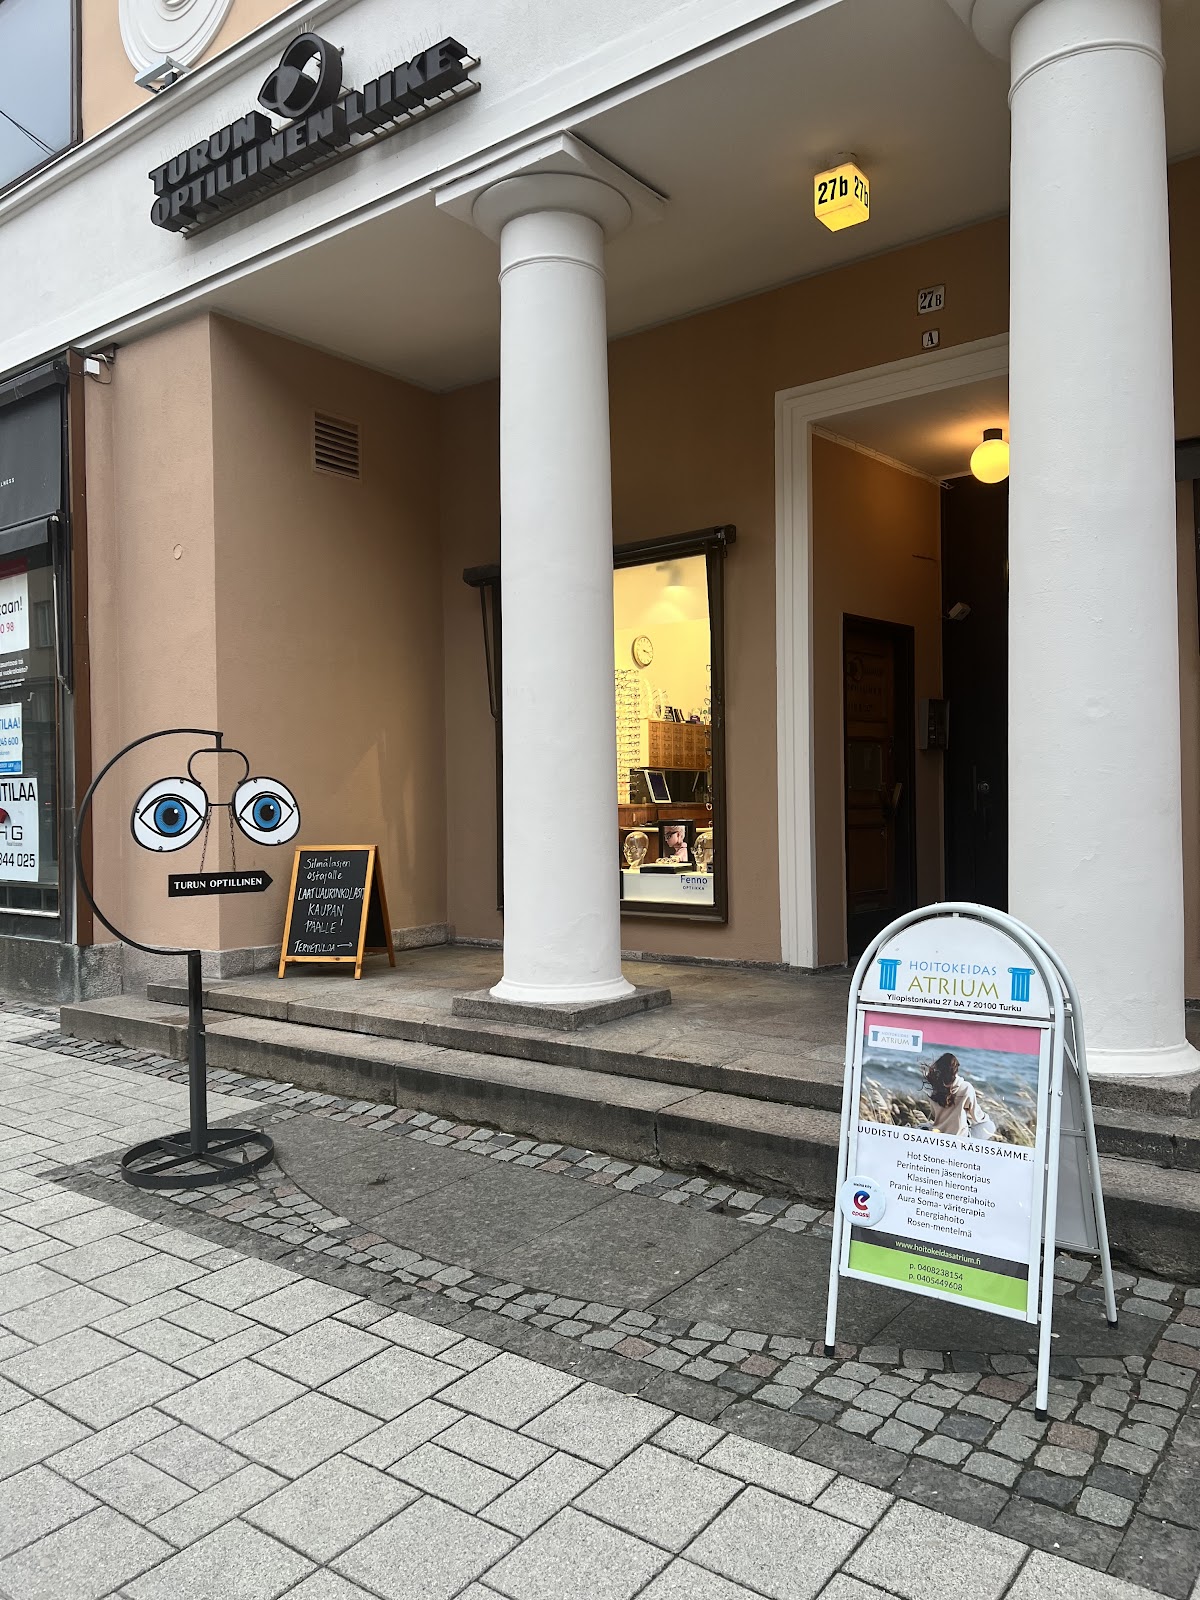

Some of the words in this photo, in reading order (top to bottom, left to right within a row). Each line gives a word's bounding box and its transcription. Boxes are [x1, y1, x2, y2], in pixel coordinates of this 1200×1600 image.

[150, 105, 344, 230] OPTILLINEN
[343, 37, 465, 130] LIIKE
[148, 110, 263, 196] TURUN
[818, 175, 848, 206] 27b
[854, 175, 869, 208] 27b
[926, 332, 935, 346] A
[8, 736, 19, 746] 600
[17, 853, 35, 867] 025
[303, 857, 350, 870] Silmälasien
[173, 880, 206, 890] TURUN
[209, 877, 263, 888] OPTILLINEN
[306, 870, 343, 885] ostajalle
[680, 874, 708, 885] Fenno
[307, 903, 344, 917] KAUPAN
[909, 960, 998, 976] HOITOKEIDAS
[907, 975, 999, 1000] ATRIUM
[886, 993, 941, 1006] Yliopistonkatu
[942, 998, 952, 1007] 27
[973, 1001, 997, 1010] 20100
[999, 1003, 1022, 1013] Turku
[880, 1036, 910, 1046] ATRIUM
[857, 1125, 900, 1139] UUDISTU
[902, 1133, 958, 1150] OSAAVISSA
[906, 1151, 921, 1161] Hot
[923, 1154, 981, 1172] Stone-hieronta
[896, 1160, 940, 1175] Perinteinen
[941, 1168, 991, 1184] jäsenkorjaus
[907, 1173, 944, 1187] Klassinen
[945, 1179, 978, 1193] hieronta
[889, 1180, 913, 1192] Pranic
[914, 1185, 944, 1199] Healing
[945, 1193, 996, 1208] energiahoito
[897, 1193, 916, 1204] Aura
[917, 1197, 942, 1208] Soma-
[943, 1202, 986, 1218] väriterapia
[915, 1207, 965, 1225] Energiahoito
[895, 1240, 981, 1266] www.hoitokeidasatrium.fi
[909, 1263, 916, 1271] p.
[917, 1263, 964, 1281] 0408238154
[908, 1273, 915, 1281] p.
[916, 1273, 963, 1292] 0405449608
